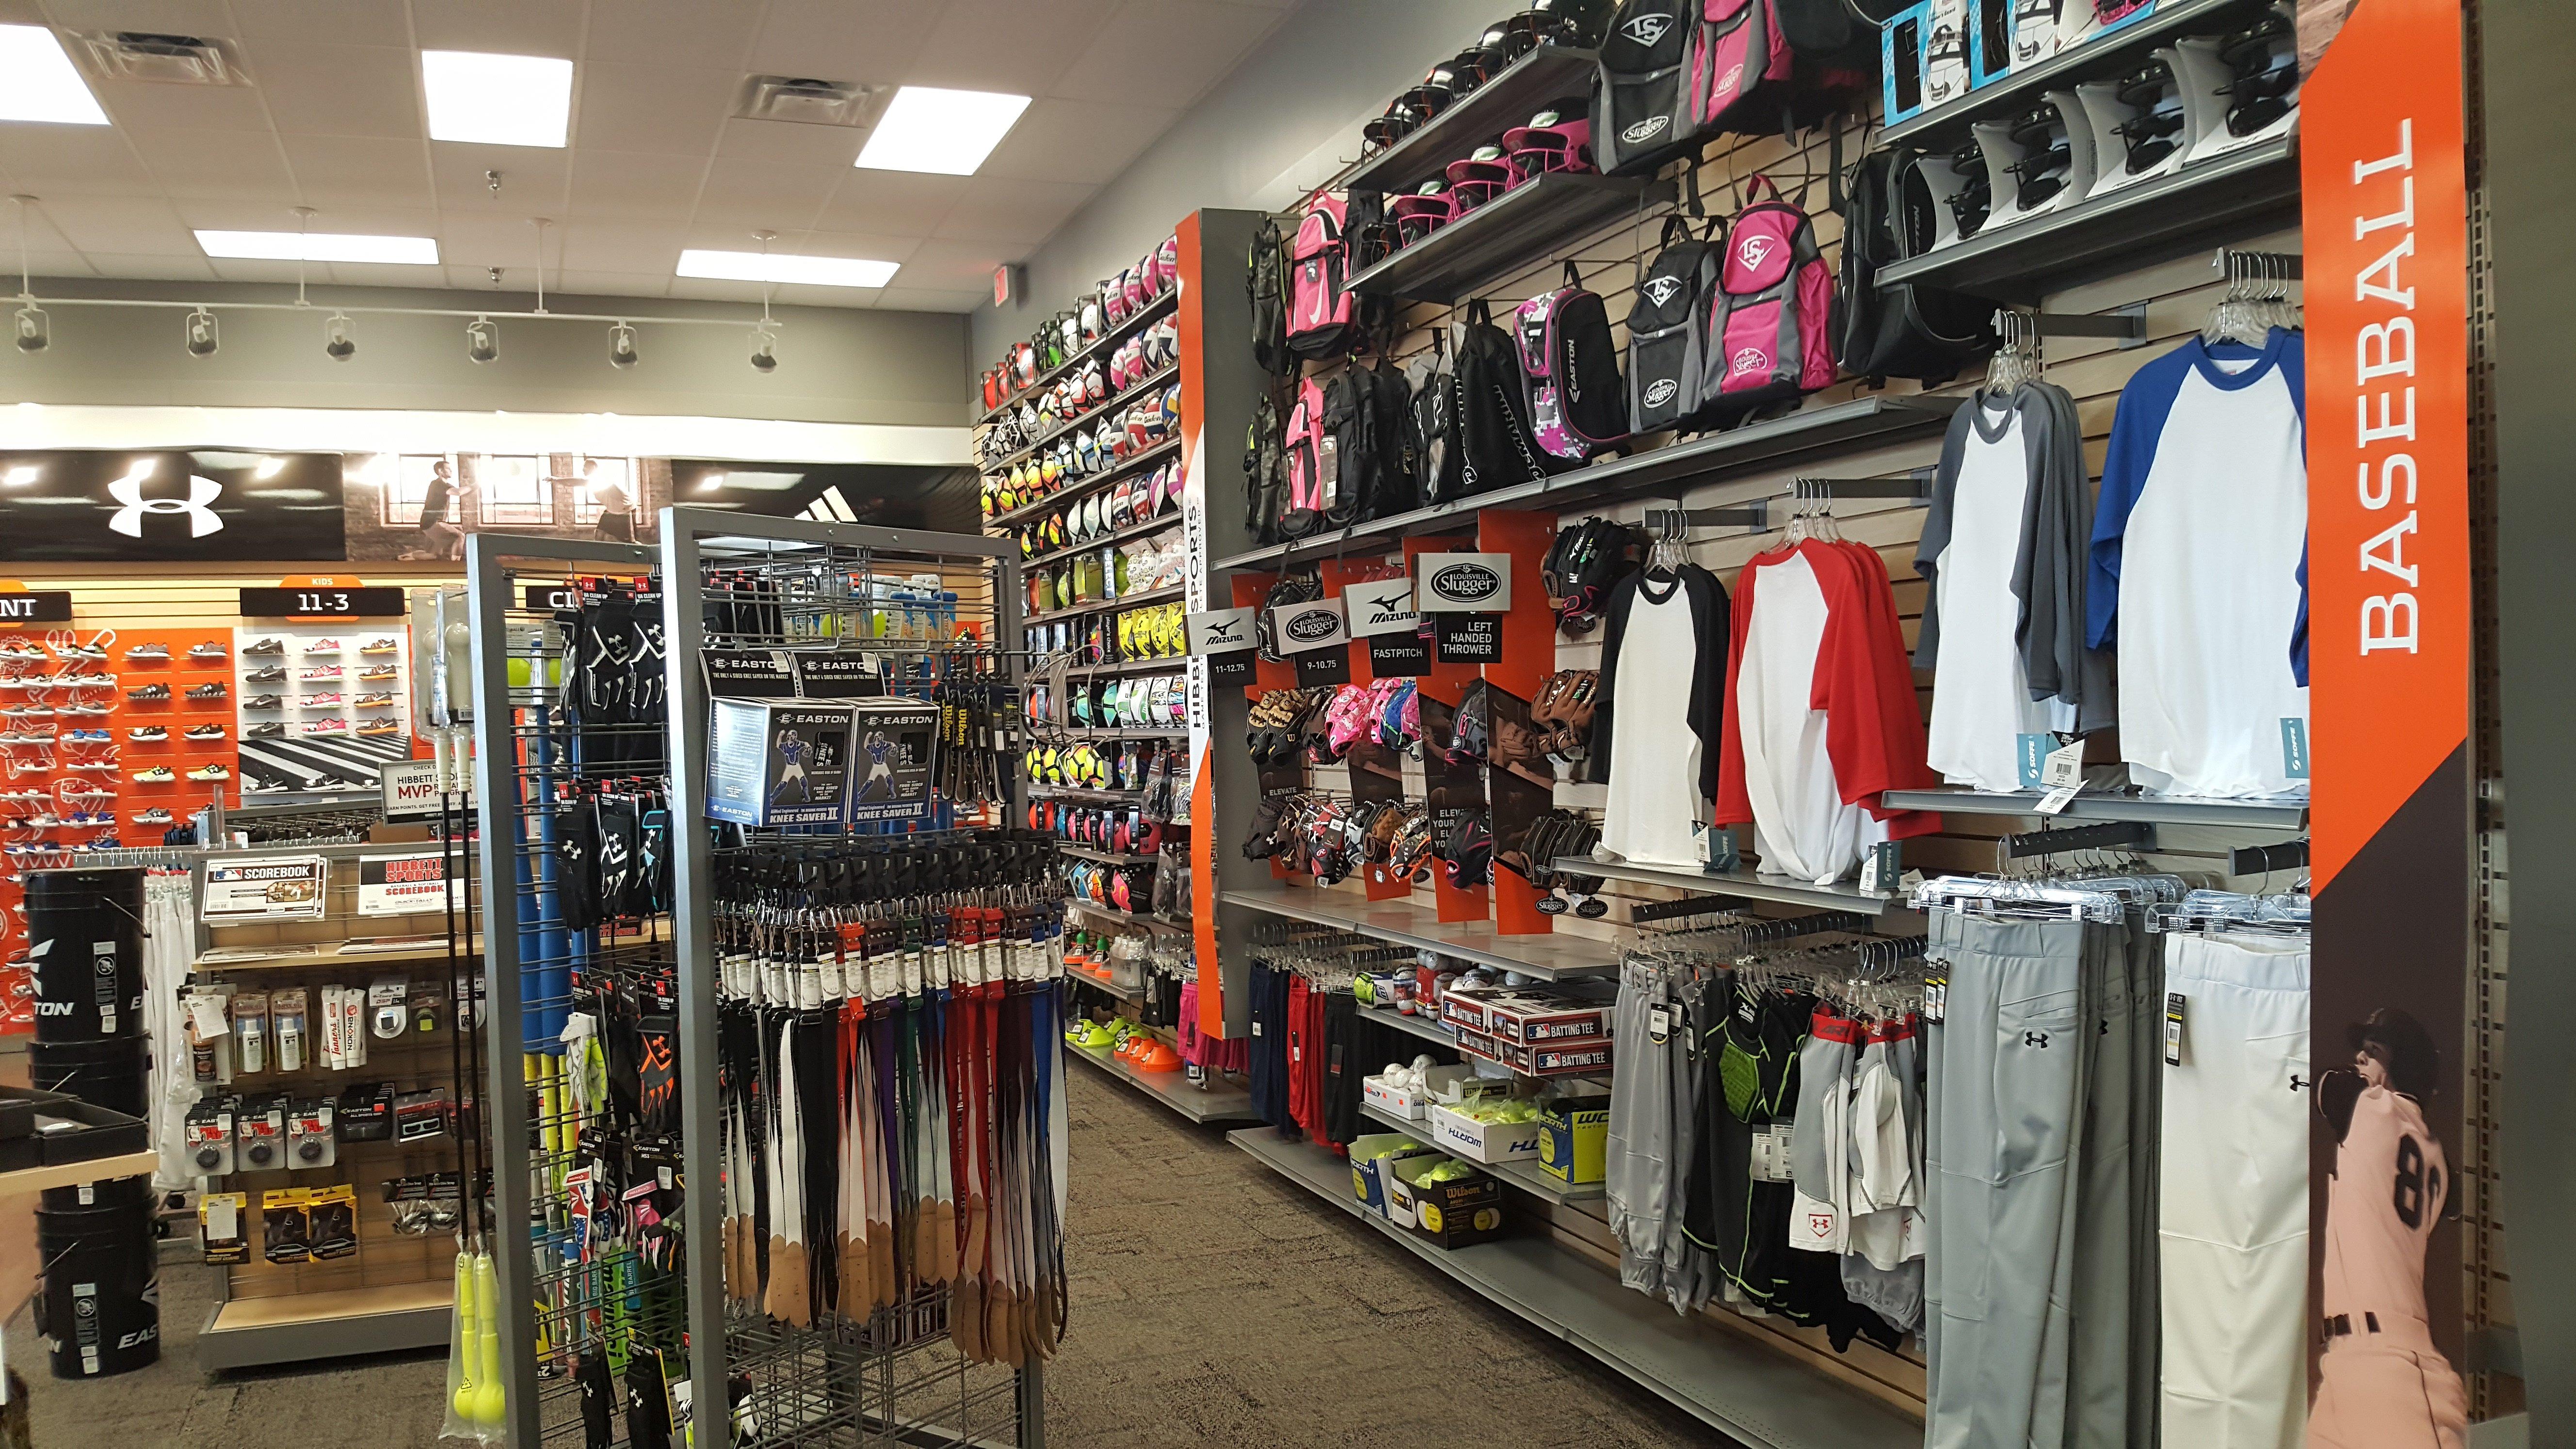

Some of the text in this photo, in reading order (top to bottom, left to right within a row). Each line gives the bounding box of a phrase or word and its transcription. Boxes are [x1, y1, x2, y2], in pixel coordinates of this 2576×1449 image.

[2354, 117, 2418, 656] BASEBALL
[1105, 553, 1113, 593] SELECT
[312, 578, 333, 586] KIDS
[1441, 575, 1492, 595] Slugger
[298, 594, 349, 611] 11-3
[1189, 505, 1201, 727] HIBBE SPORTS
[1302, 615, 1332, 626] LOUISVILLE
[1293, 619, 1335, 636] Slugger
[1468, 622, 1492, 632] LEFT
[1451, 633, 1492, 643] HANDED
[1374, 648, 1423, 659] FASTPITCH
[1443, 644, 1492, 654] THROWER
[732, 660, 776, 669] EASTO
[1215, 663, 1245, 674] 11-12.75
[1307, 660, 1336, 670] 9-10.75
[883, 716, 934, 724] EASTON
[958, 708, 967, 746] Wilson
[2289, 728, 2299, 759] SOFFE
[397, 774, 433, 784] HIBBETT
[398, 784, 433, 799] MVP
[1269, 787, 1297, 796] ELEVATE
[722, 807, 753, 817] EASTON
[770, 814, 794, 823] KNEE
[796, 813, 826, 822] SAVER
[857, 810, 881, 820] KNEE
[882, 808, 912, 818] SAVER
[1433, 820, 1455, 828] YOUR
[386, 858, 443, 873] HIBBETT
[244, 866, 310, 879] SCOREBOOK
[386, 869, 442, 883] SPORTS
[386, 885, 445, 895] SCOREBOOK
[1539, 902, 1564, 911] Slugger
[1580, 906, 1605, 914] Slugger
[1457, 1008, 1481, 1027] BATTING TEE
[1551, 1022, 1594, 1037] BATTING TEE
[331, 1022, 341, 1055] Tanners
[1469, 1036, 1493, 1054] BATTING TEE
[1562, 1051, 1606, 1066] BATTING TEE
[1449, 1127, 1481, 1148] WORTH
[1447, 1186, 1480, 1199] Wilson
